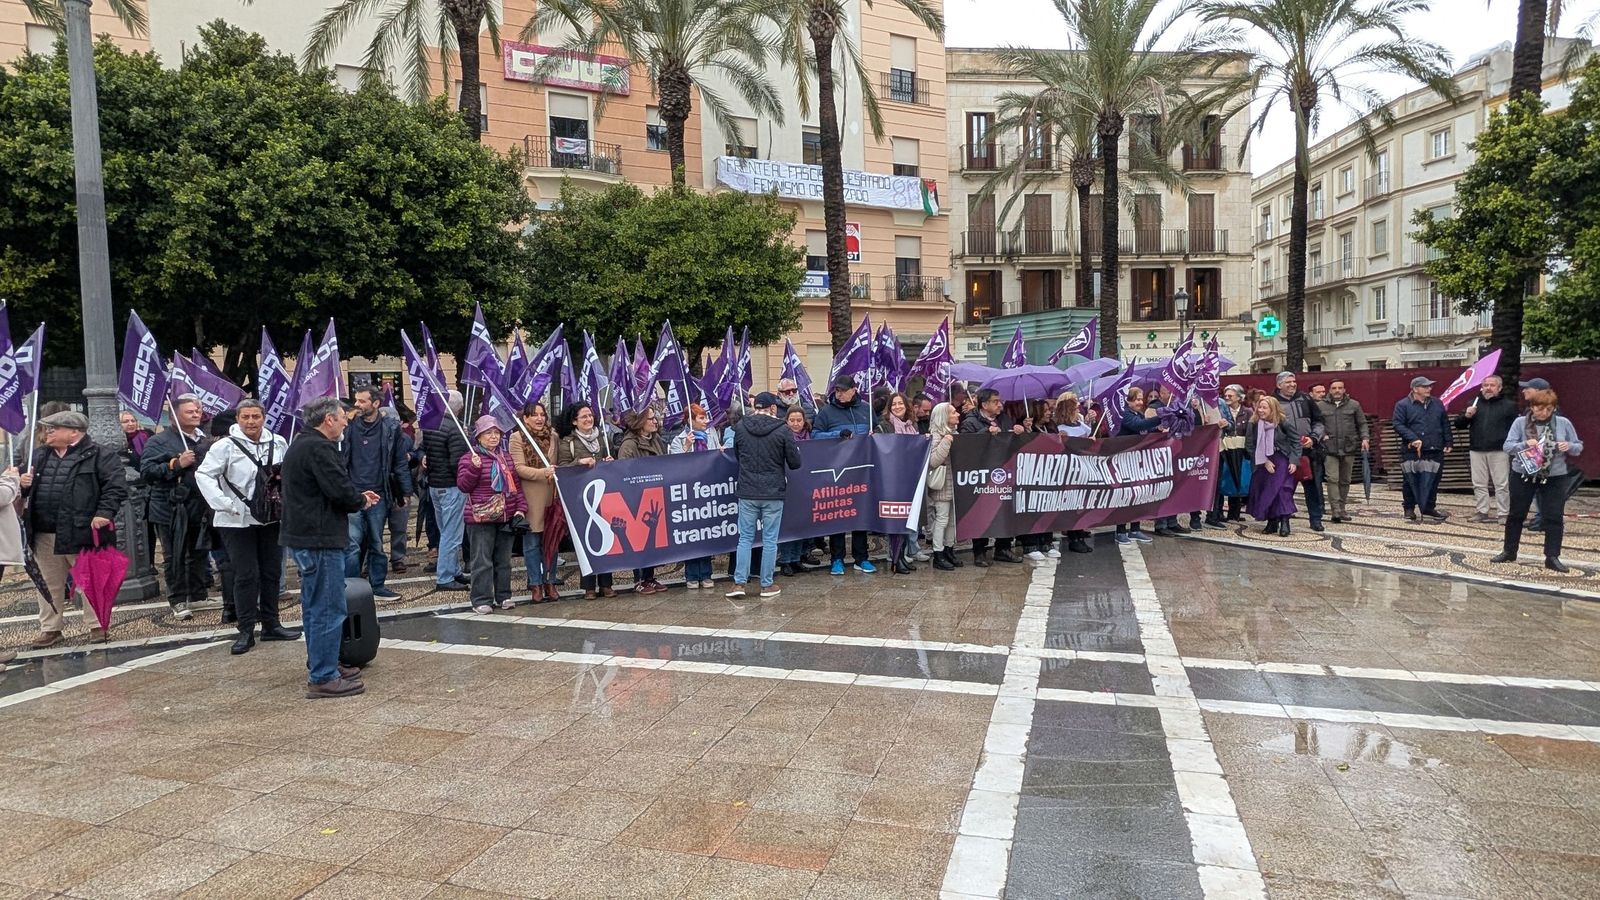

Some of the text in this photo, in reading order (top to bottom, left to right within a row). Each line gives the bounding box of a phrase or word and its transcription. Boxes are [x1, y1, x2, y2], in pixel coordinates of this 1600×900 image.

[847, 252, 859, 260] GT
[957, 470, 989, 486] UGT
[670, 484, 688, 502] El
[812, 483, 868, 499] Afiliadas
[973, 485, 1012, 495] Andalucía
[812, 497, 853, 511] Juntas
[1028, 489, 1087, 513] INTERNACIONAL
[1086, 489, 1099, 509] DE
[1097, 489, 1110, 509] LA
[1109, 487, 1132, 508] MUJER
[582, 479, 668, 556] 8M
[813, 508, 857, 522] Fuertes
